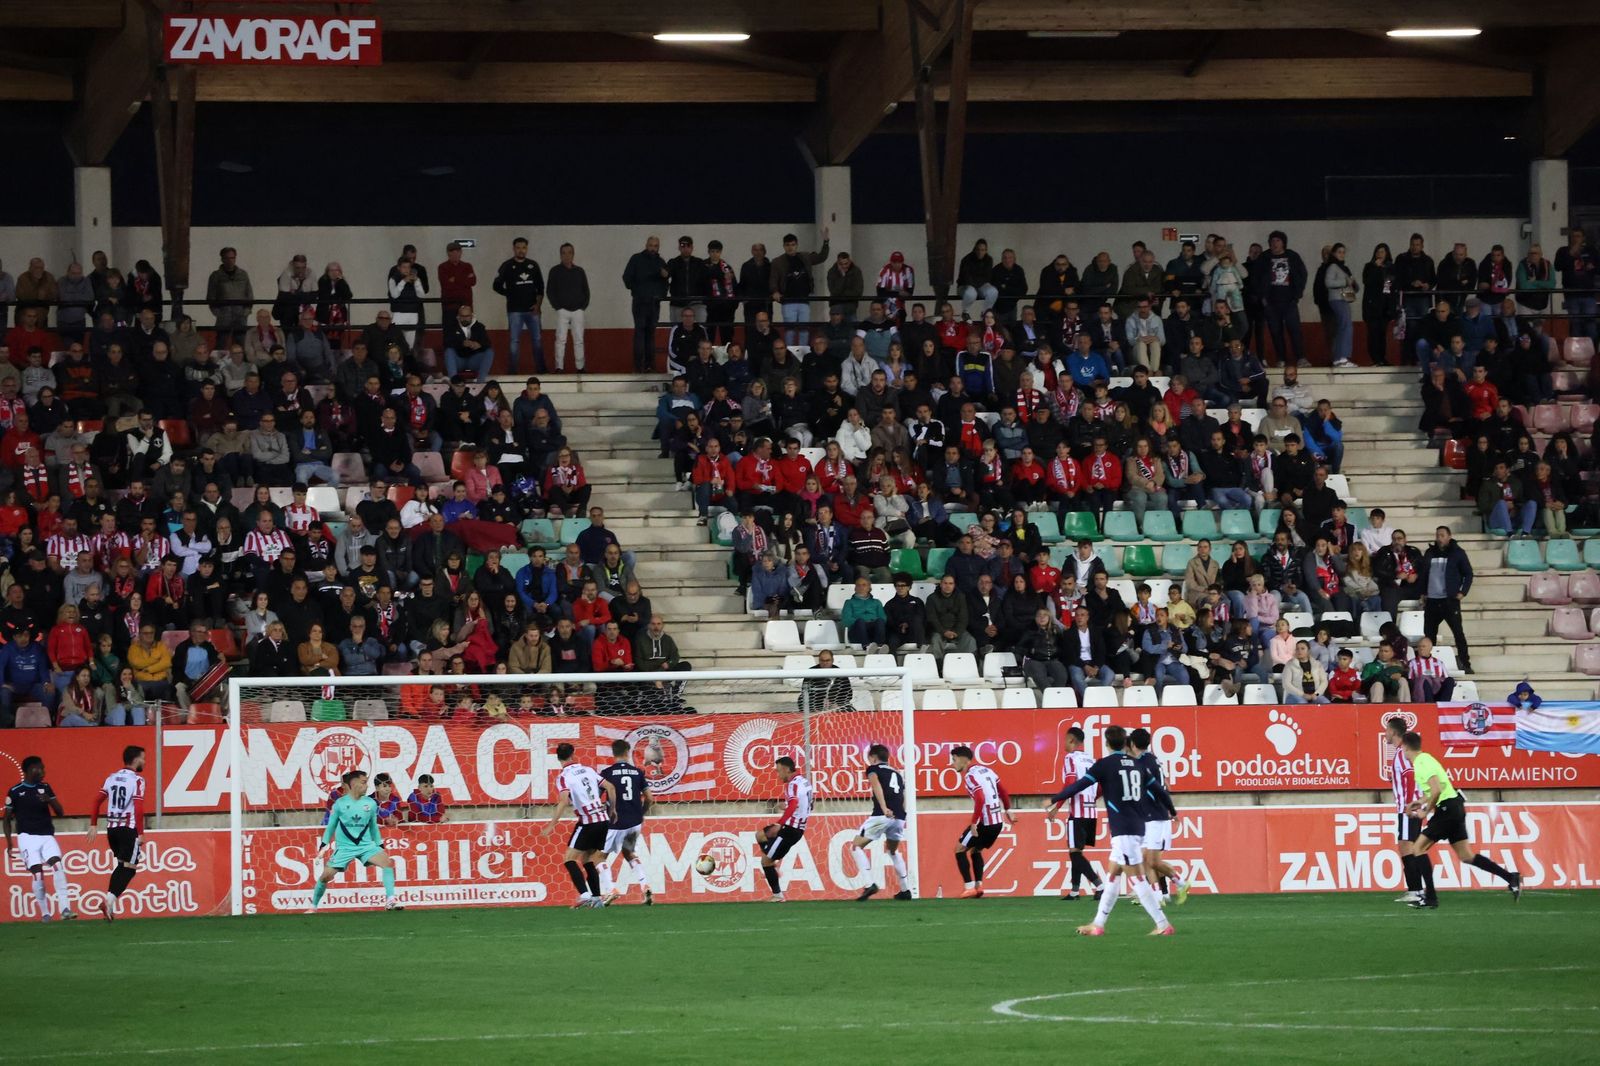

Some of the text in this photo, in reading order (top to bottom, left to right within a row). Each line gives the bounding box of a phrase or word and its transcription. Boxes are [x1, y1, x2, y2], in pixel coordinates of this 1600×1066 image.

[1216, 752, 1351, 787] podoactiva
[1235, 775, 1350, 786] PODOLOGÍA Y BIOMECÁNICA
[1446, 766, 1578, 781] AYUNTAMIENTO
[621, 776, 632, 800] 3
[889, 772, 900, 794] 4
[1118, 769, 1141, 801] 18
[477, 830, 511, 847] del
[1335, 810, 1540, 846] PERNAS
